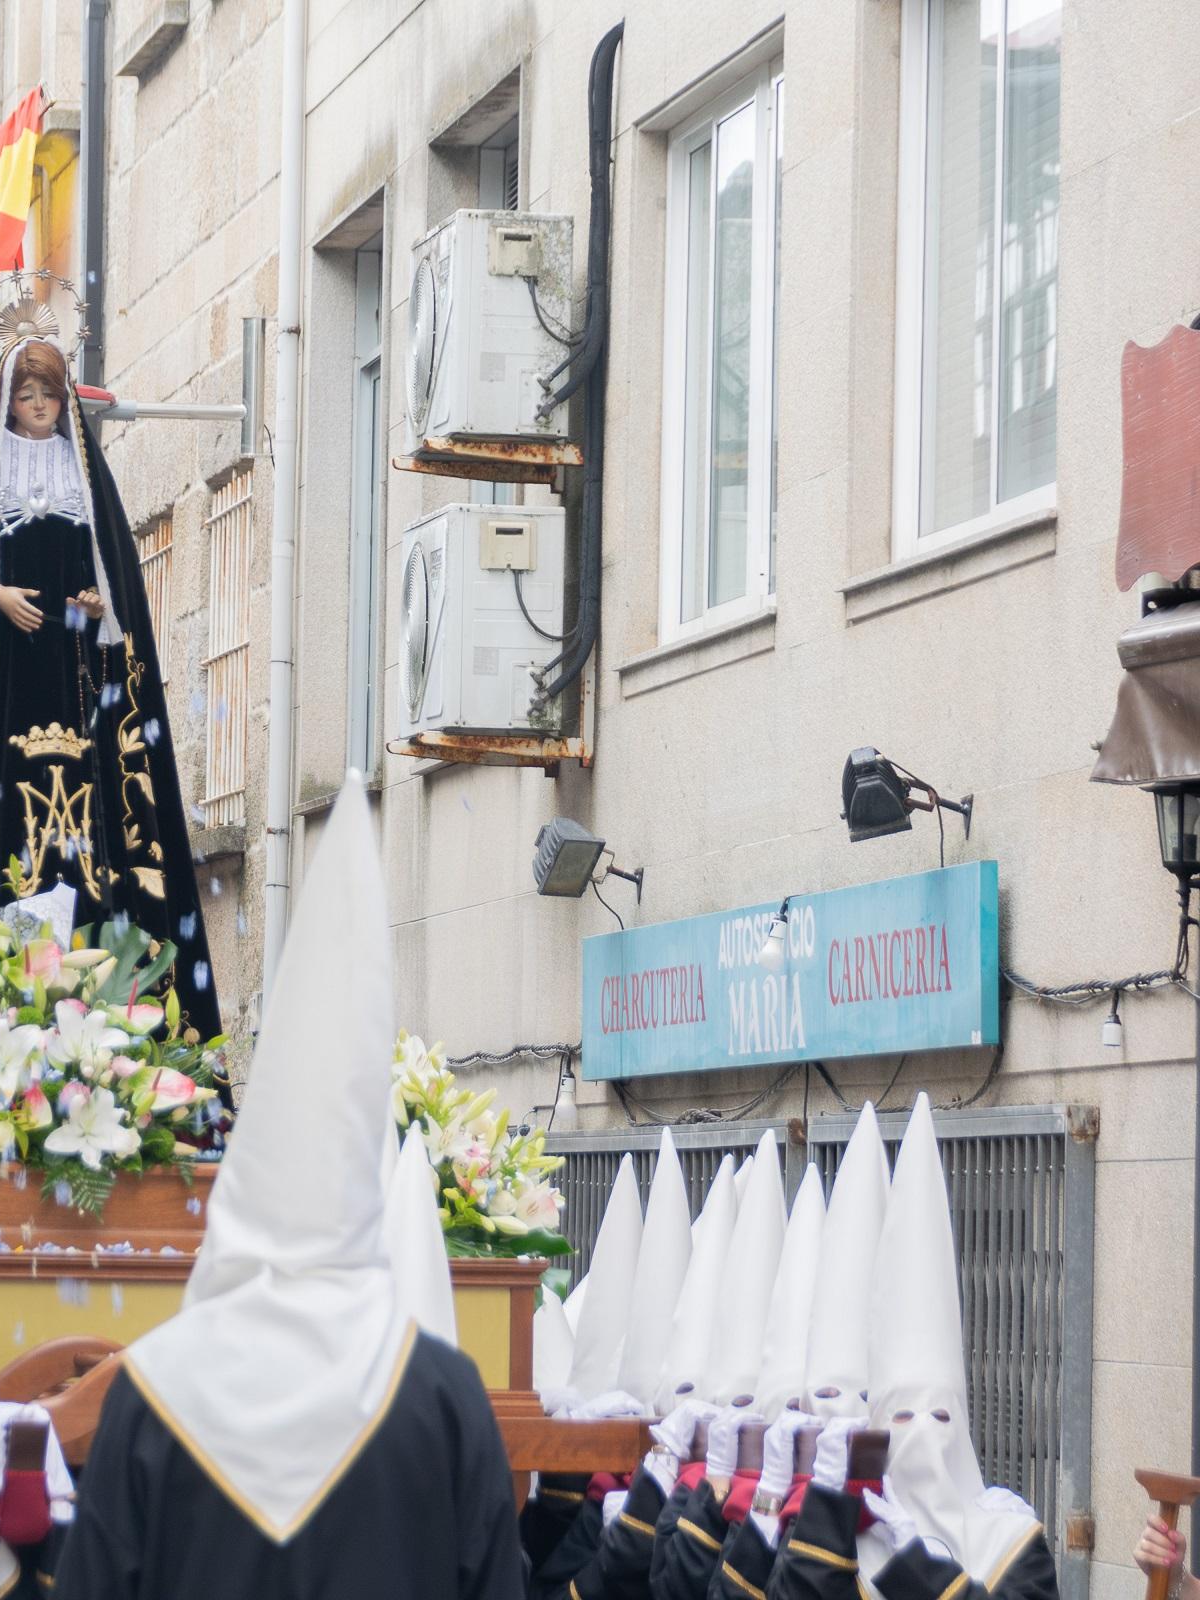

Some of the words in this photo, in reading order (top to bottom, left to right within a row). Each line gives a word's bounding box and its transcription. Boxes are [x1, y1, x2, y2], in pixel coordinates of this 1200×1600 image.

[718, 905, 815, 970] AUTOSEICIO
[827, 923, 952, 1007] CARNICERIA
[601, 963, 706, 1034] CHARCUTERIA
[728, 972, 807, 1056] MARIA
